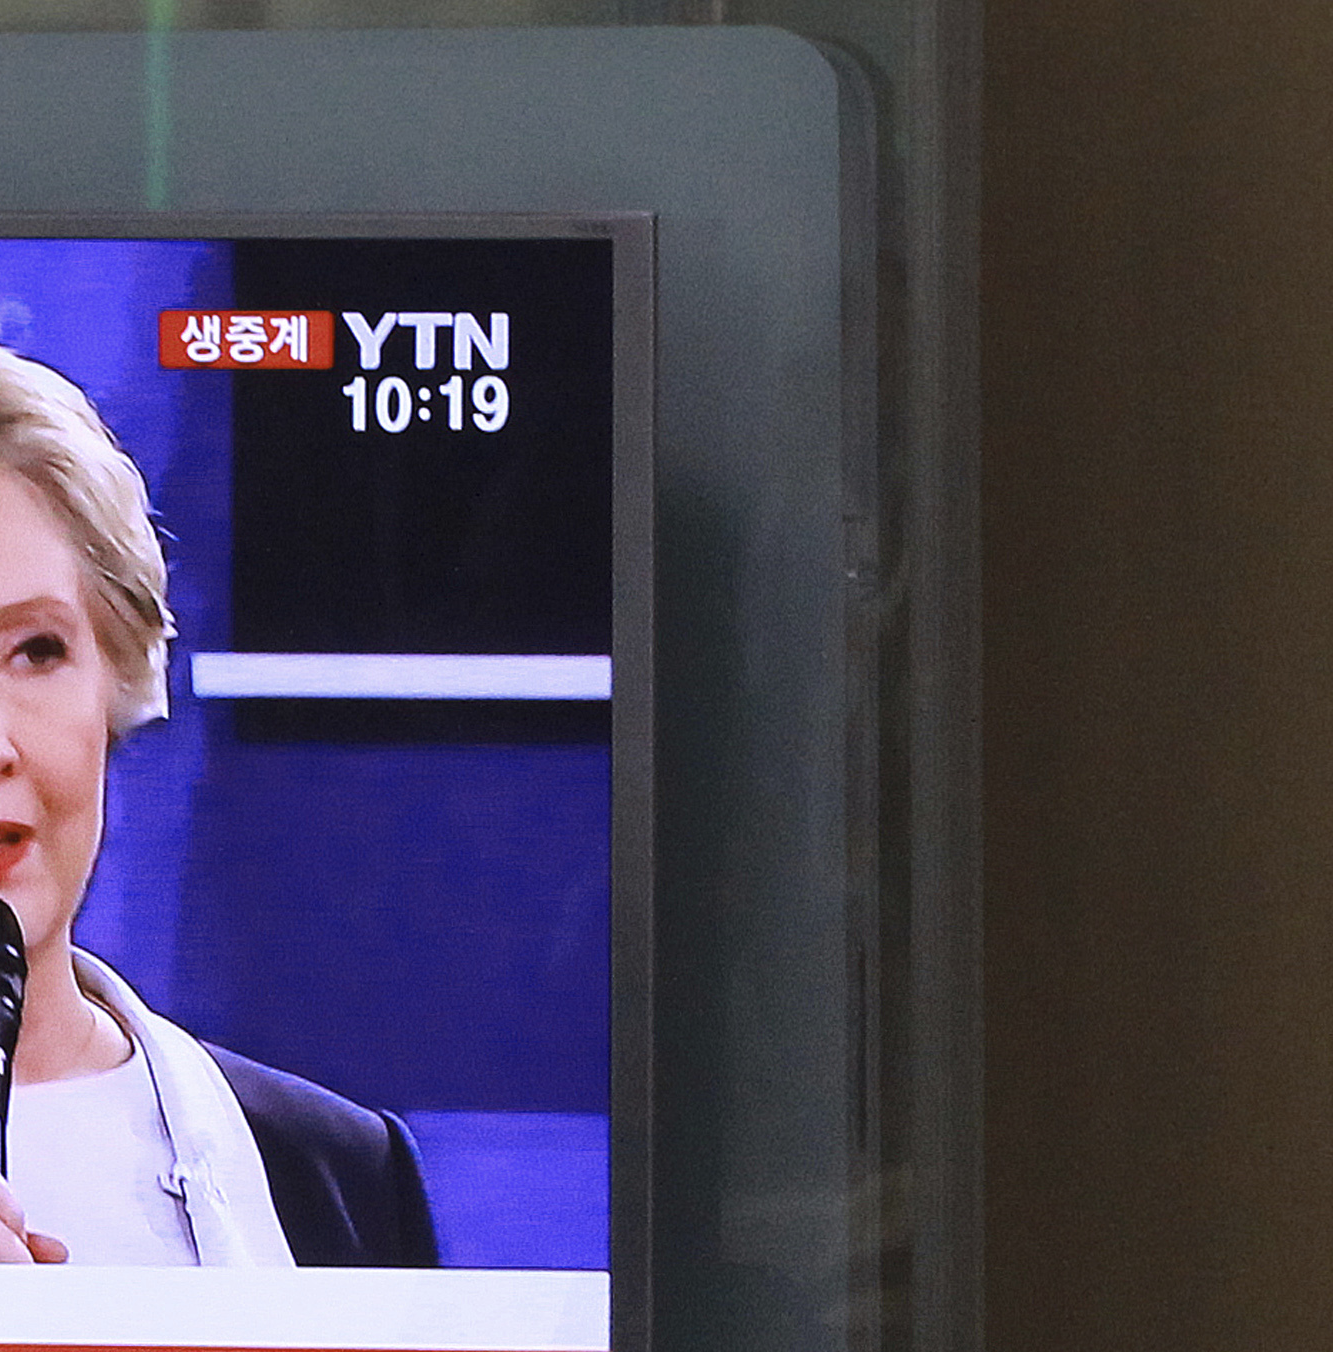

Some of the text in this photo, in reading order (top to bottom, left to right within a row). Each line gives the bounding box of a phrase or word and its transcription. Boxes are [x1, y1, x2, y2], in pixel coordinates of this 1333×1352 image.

[179, 313, 309, 364] 생중계
[341, 311, 511, 371] YTN
[342, 375, 511, 433] 10:19
